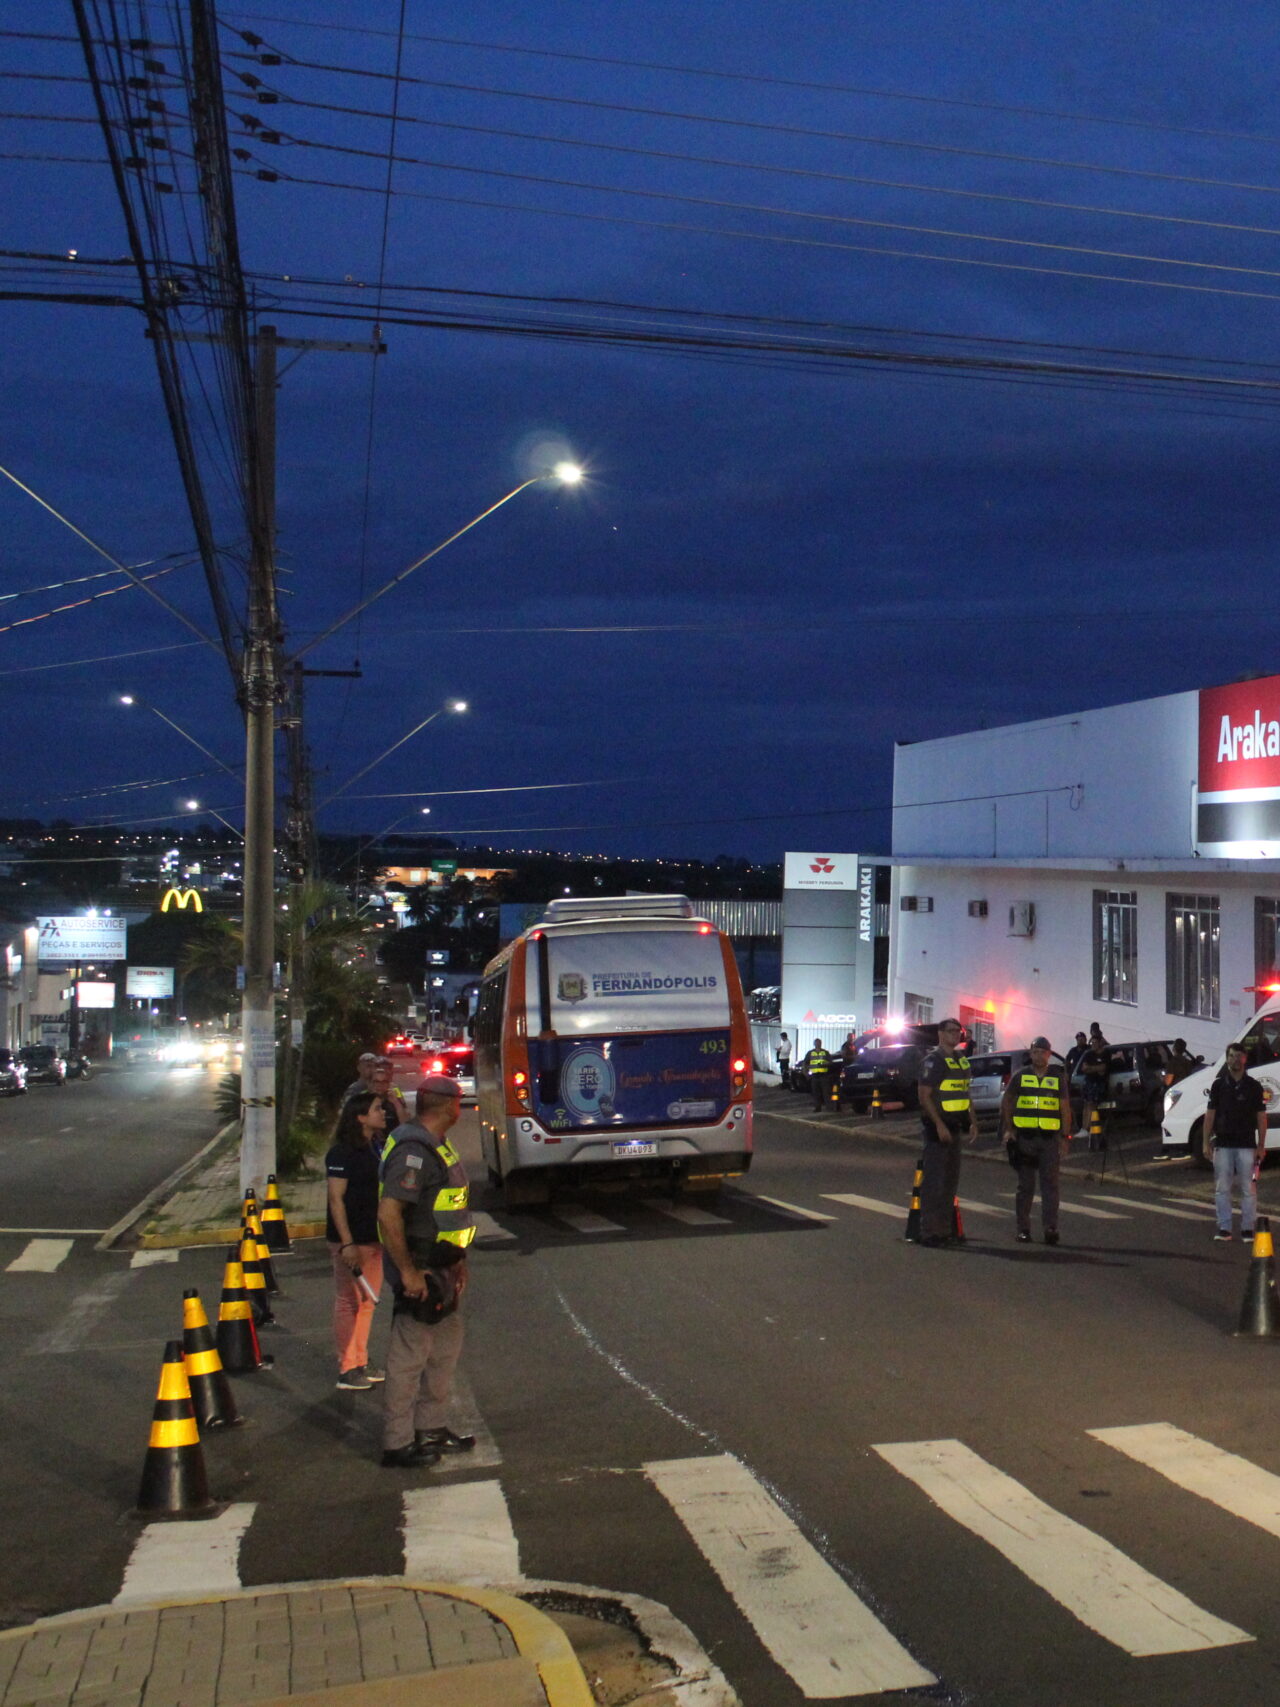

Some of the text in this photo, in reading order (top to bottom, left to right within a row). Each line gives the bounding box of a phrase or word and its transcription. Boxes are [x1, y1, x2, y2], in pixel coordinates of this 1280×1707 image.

[860, 868, 872, 942] ARAKAKI
[61, 919, 125, 929] AUTOSERVICE
[592, 972, 639, 981] PREFEITURA
[593, 975, 717, 992] FERNANDÓPOLIS
[699, 1039, 727, 1054] 493
